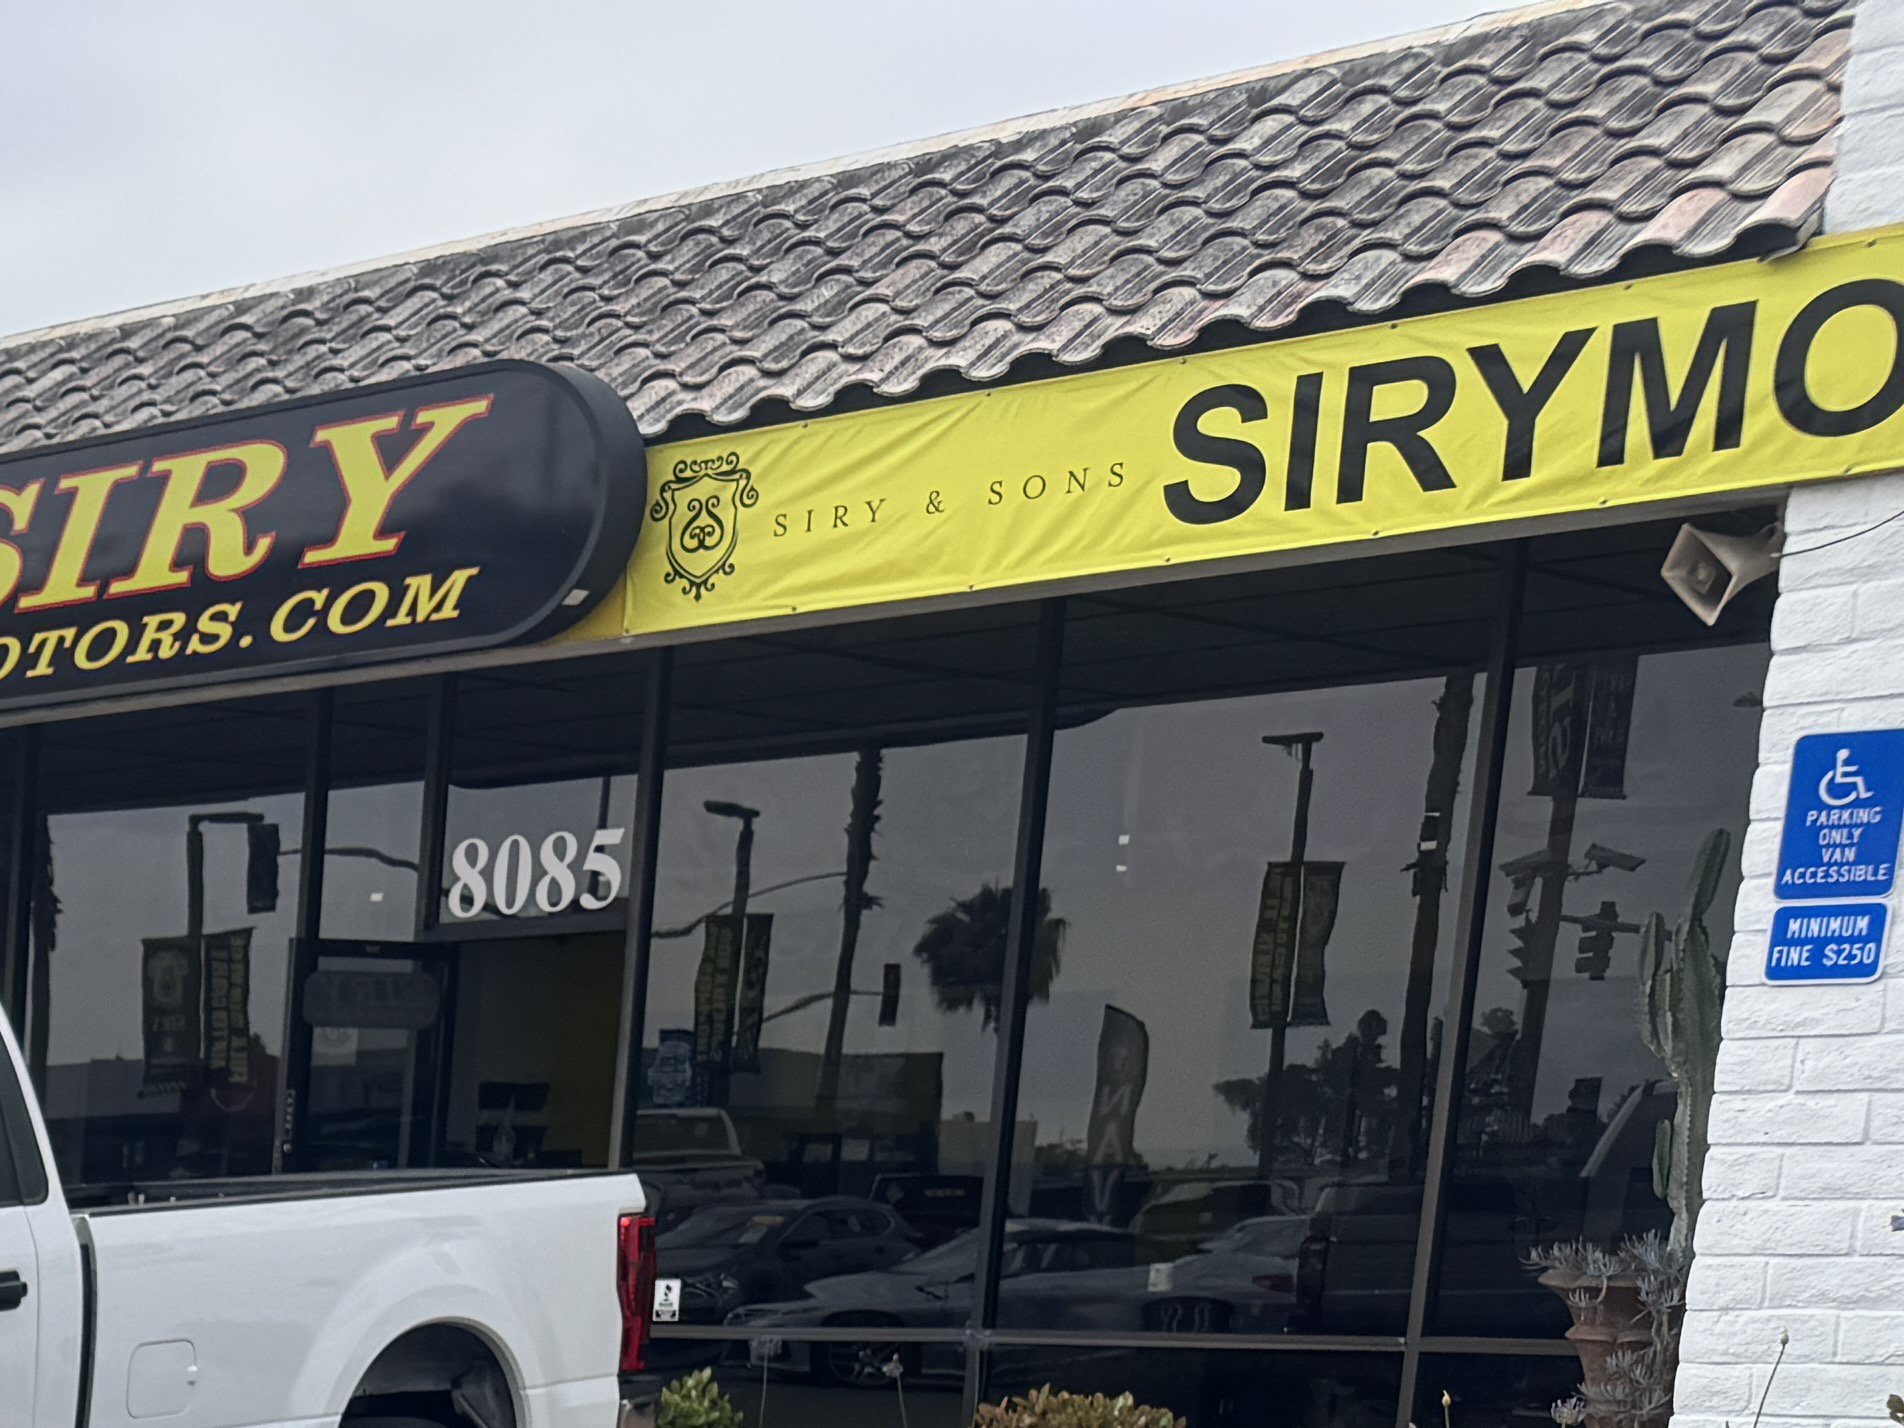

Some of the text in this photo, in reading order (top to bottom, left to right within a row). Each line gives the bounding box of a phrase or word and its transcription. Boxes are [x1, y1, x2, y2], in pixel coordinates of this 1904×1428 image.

[1162, 278, 1904, 525] SIRYMO
[773, 462, 1125, 537] SIRY & SONS
[1806, 807, 1882, 827] PARKING
[1819, 827, 1864, 846] ONLY
[1821, 847, 1857, 863] VAN
[448, 828, 625, 918] 8085
[1781, 863, 1891, 885] ACCESSIBLE
[1787, 915, 1871, 939] MINIMUM
[1771, 942, 1877, 968] FINE $250
